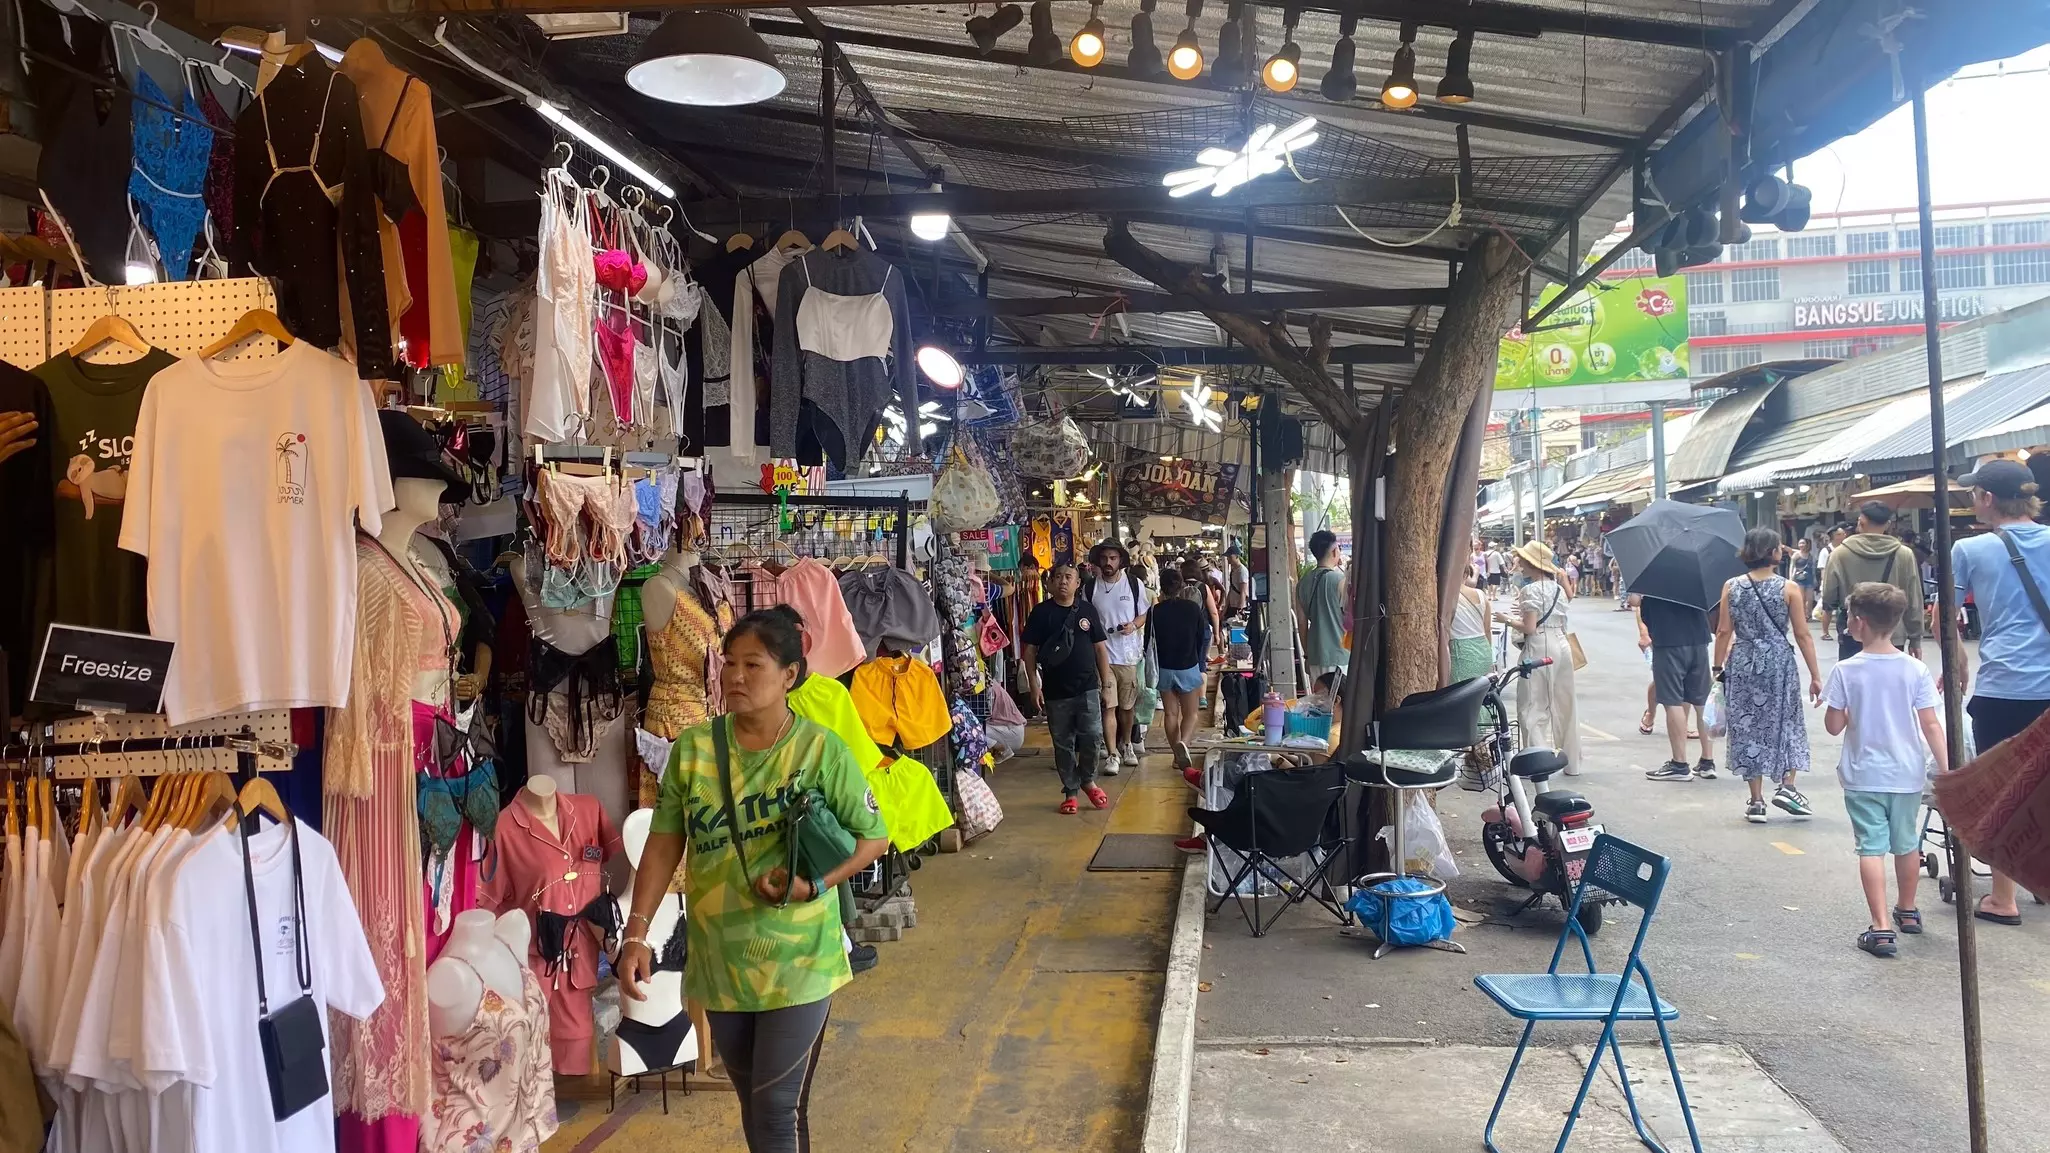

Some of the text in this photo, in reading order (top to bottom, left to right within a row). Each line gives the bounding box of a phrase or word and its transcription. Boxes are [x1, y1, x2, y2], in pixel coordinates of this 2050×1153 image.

[1794, 296, 1985, 327] BANGSUE JUNTION
[777, 471, 793, 481] 100
[962, 531, 987, 540] SALE
[60, 654, 152, 681] Freesize
[696, 836, 728, 855] HALF
